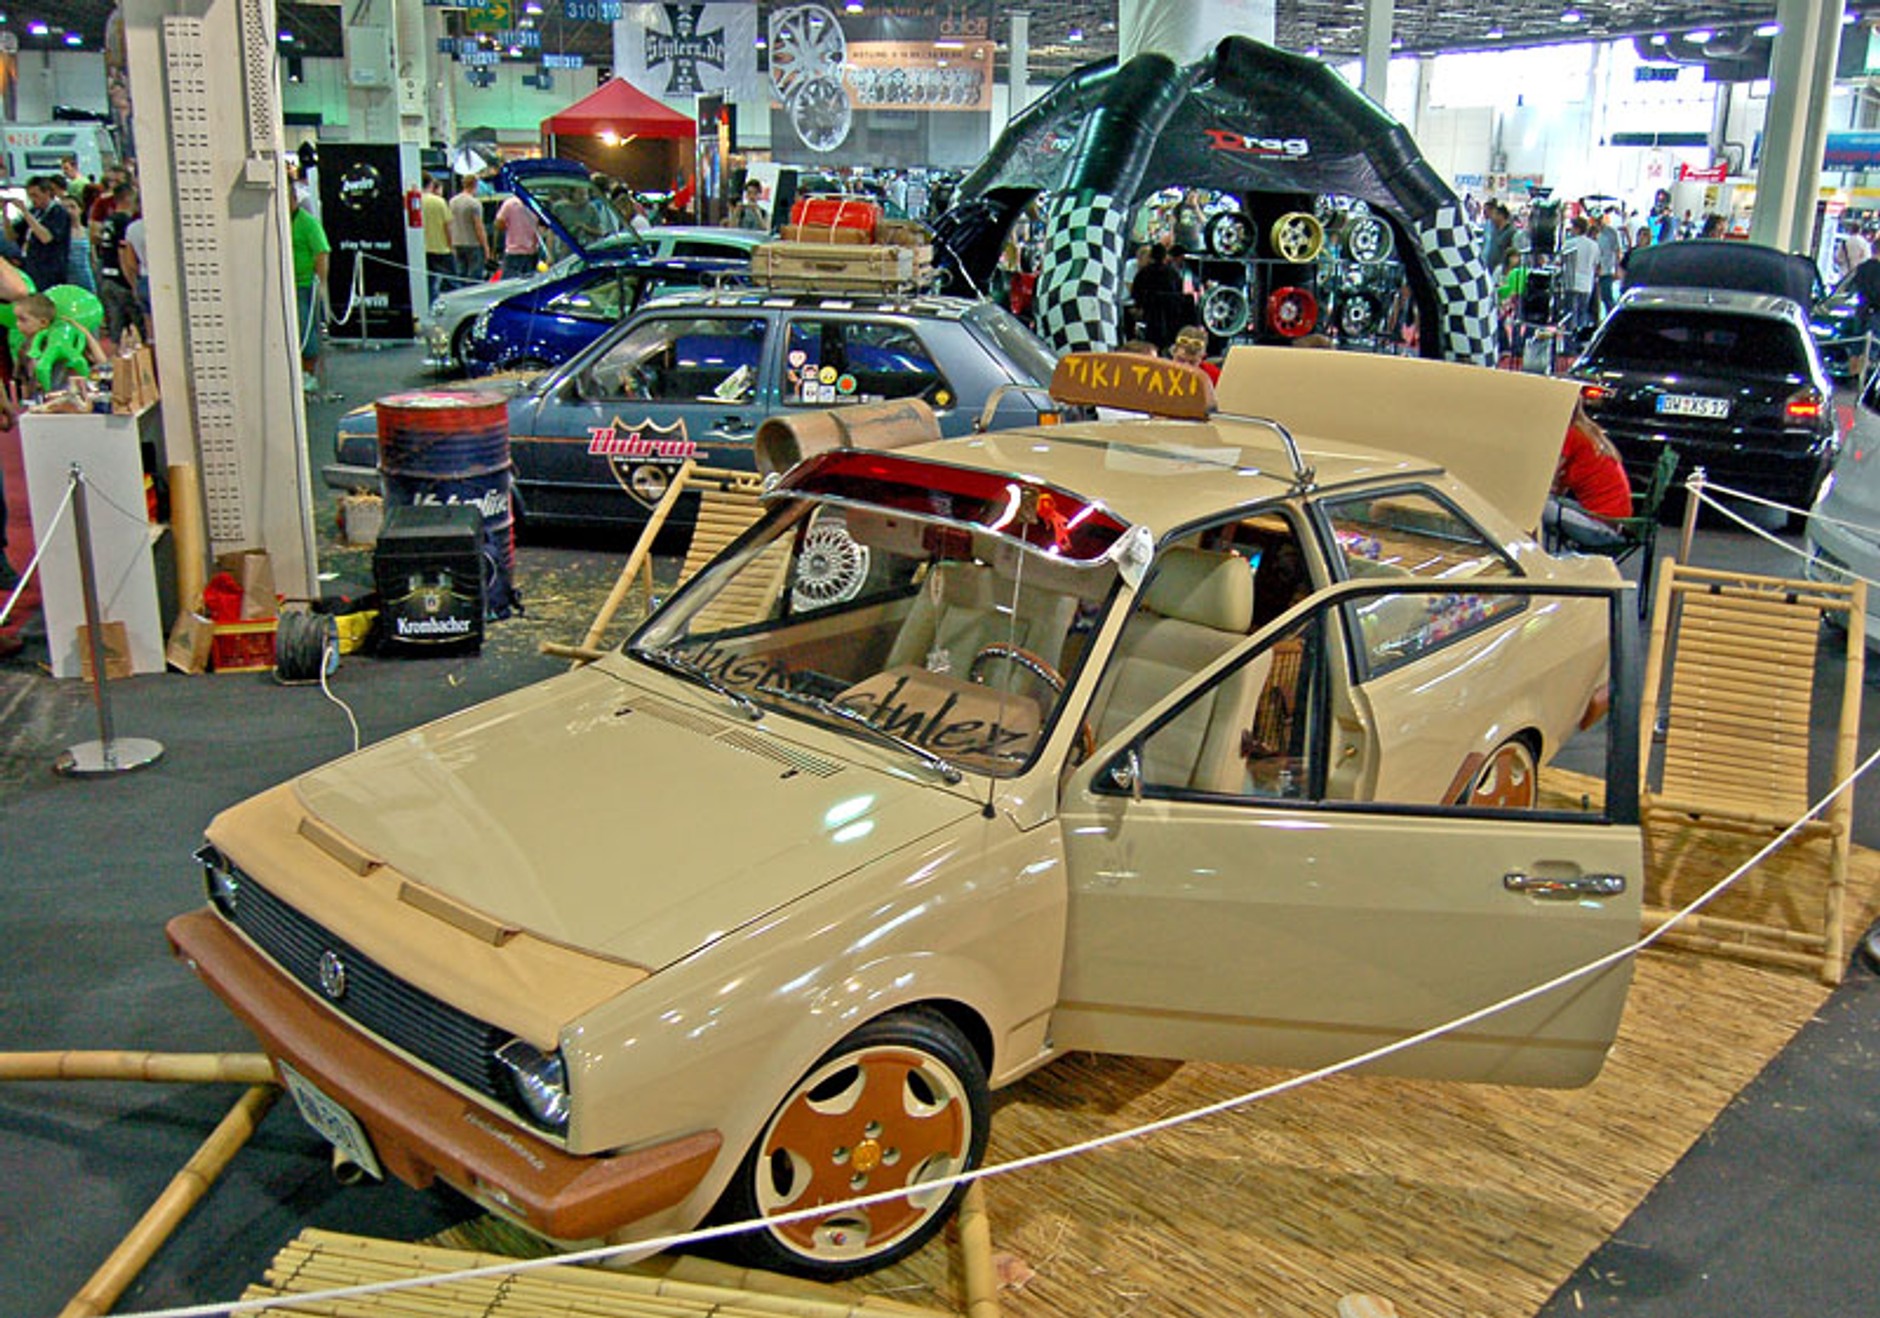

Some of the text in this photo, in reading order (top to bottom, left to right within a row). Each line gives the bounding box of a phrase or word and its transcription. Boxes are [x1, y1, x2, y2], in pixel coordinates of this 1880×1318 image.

[567, 4, 622, 18] 310 310
[1203, 128, 1309, 157] Drag
[1064, 357, 1199, 397] TIKI TAXI
[396, 616, 472, 635] Krombacher
